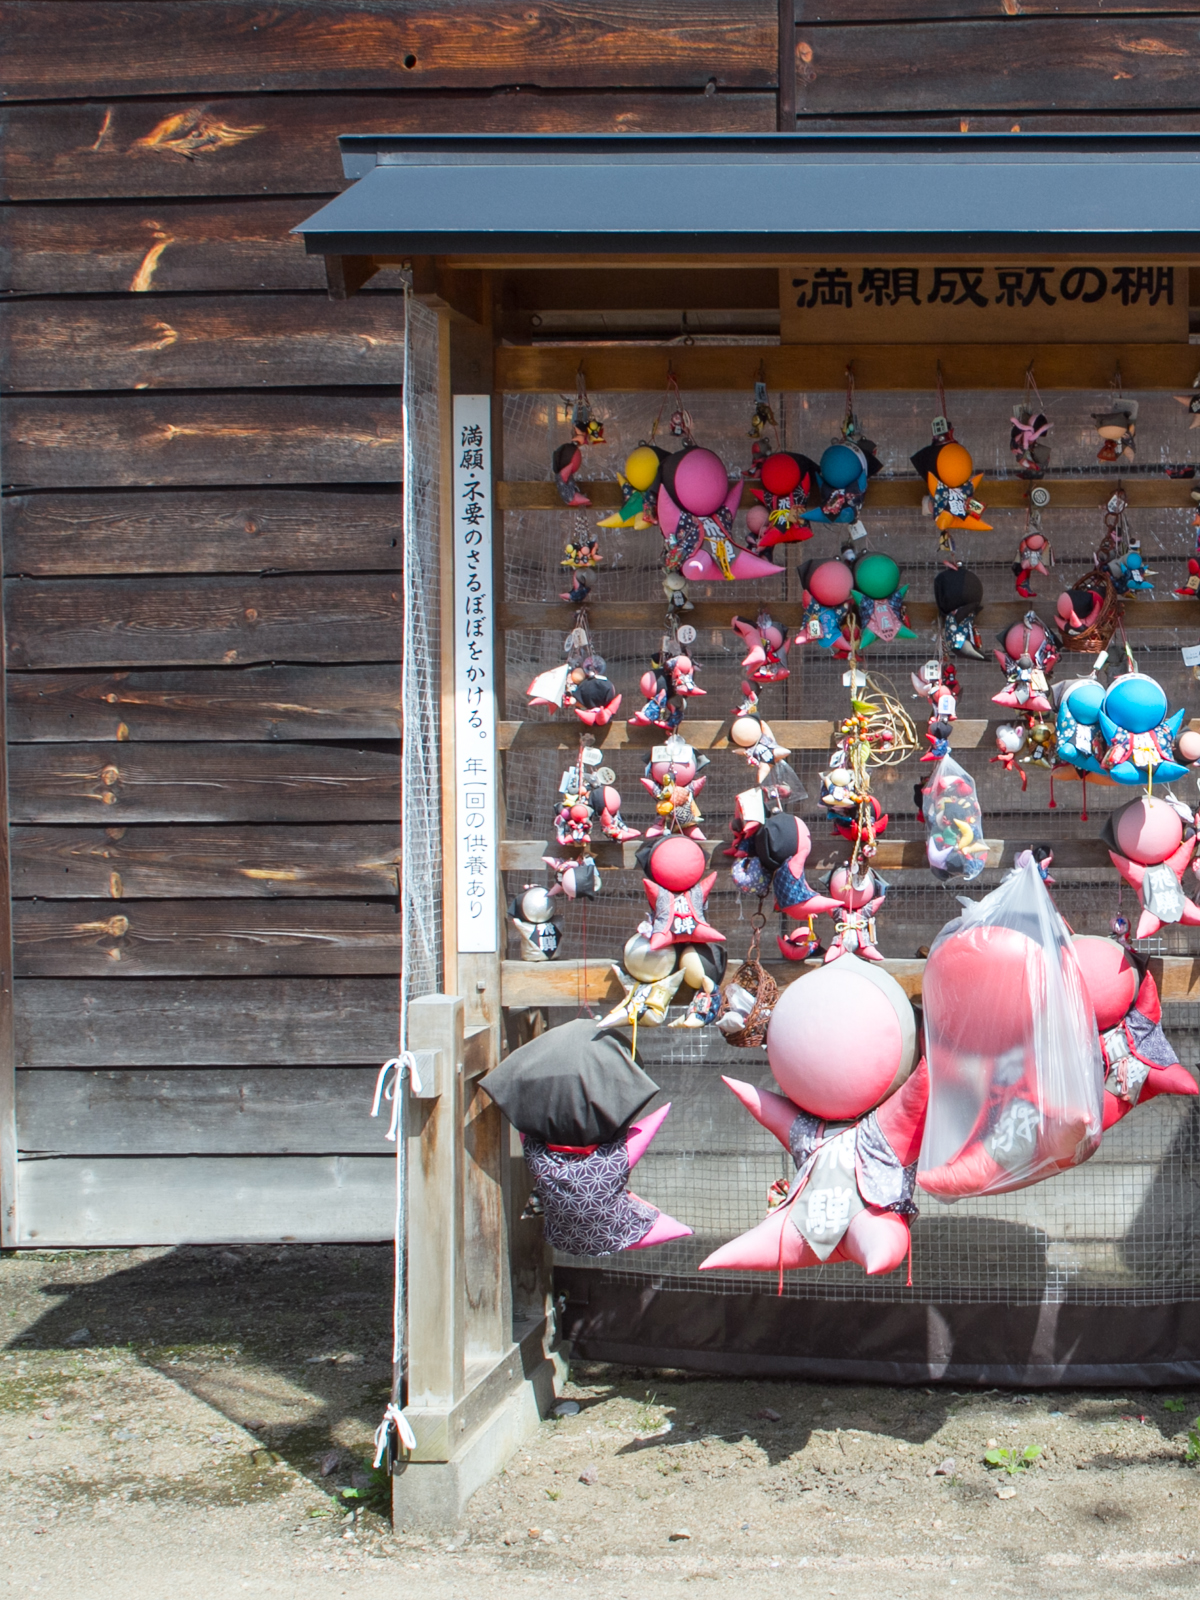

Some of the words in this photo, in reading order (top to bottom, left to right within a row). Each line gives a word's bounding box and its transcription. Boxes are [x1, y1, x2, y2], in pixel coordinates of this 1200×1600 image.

[792, 266, 1174, 308] 満願成就の棚
[463, 757, 488, 919] 年一回の供養あり
